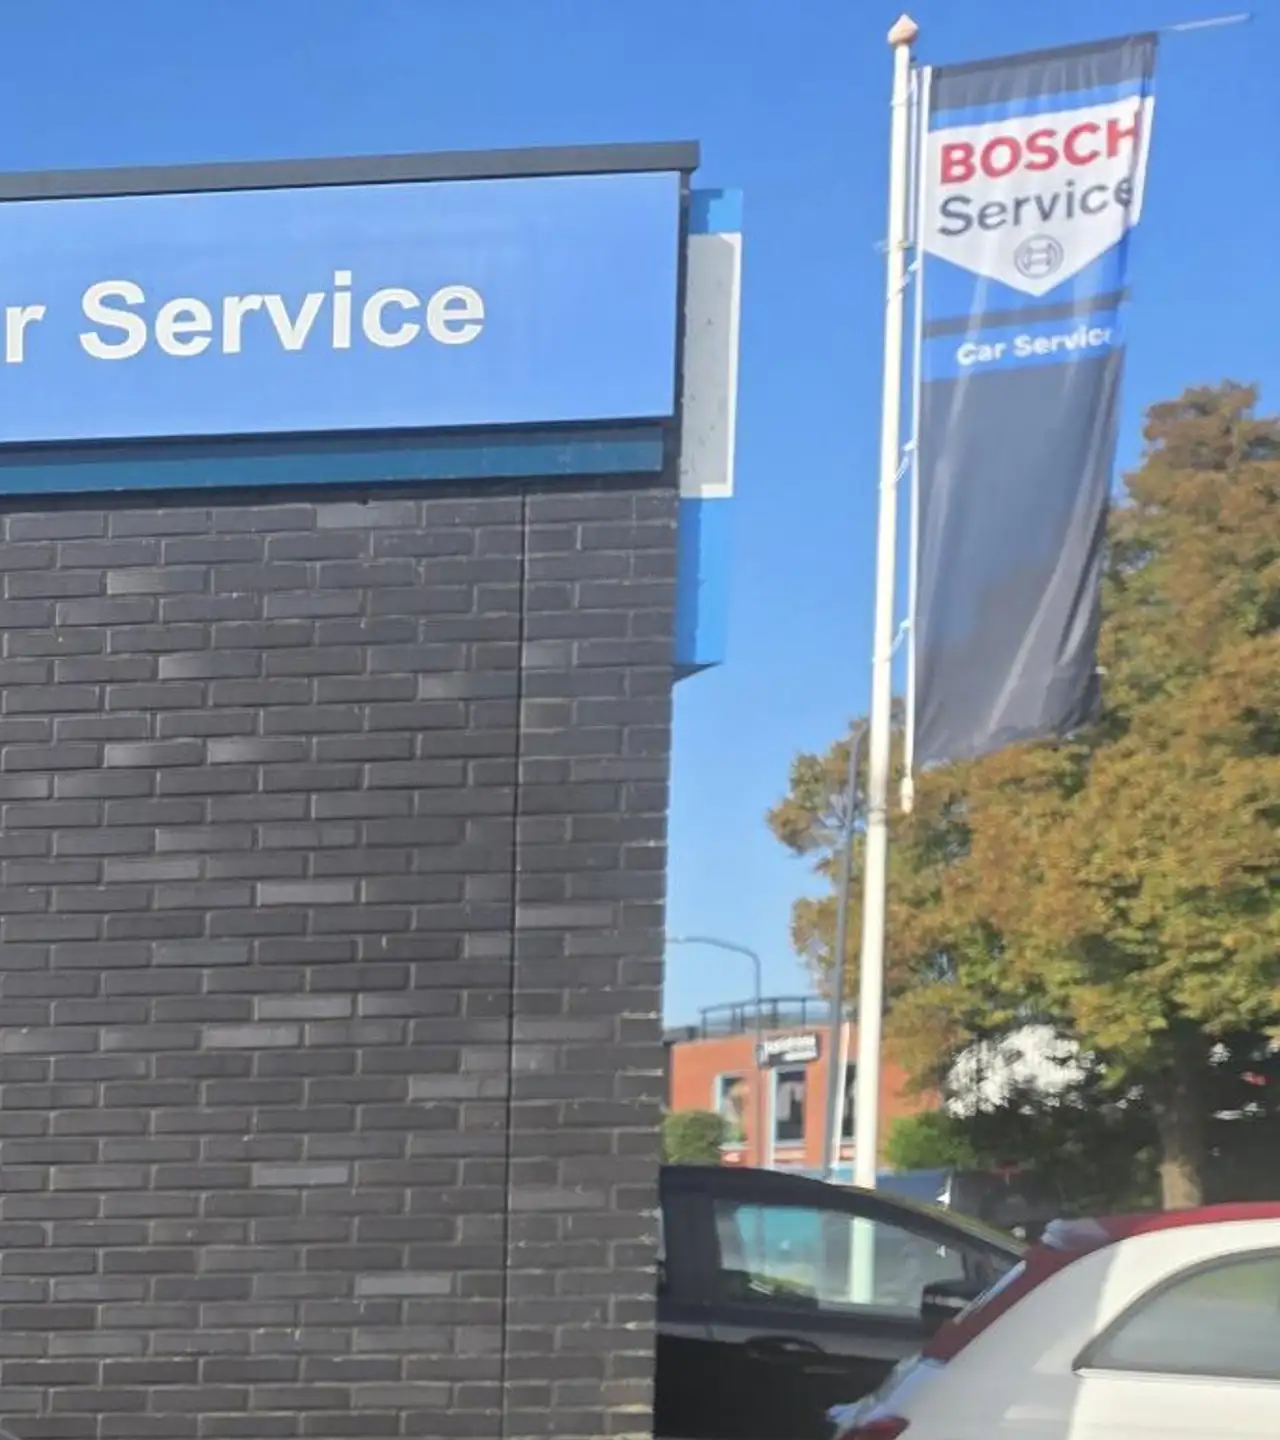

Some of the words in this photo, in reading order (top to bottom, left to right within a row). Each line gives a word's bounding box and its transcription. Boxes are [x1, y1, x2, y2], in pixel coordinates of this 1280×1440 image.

[940, 110, 1143, 184] BOSCH
[79, 270, 486, 361] Service
[956, 342, 1007, 366] Car
